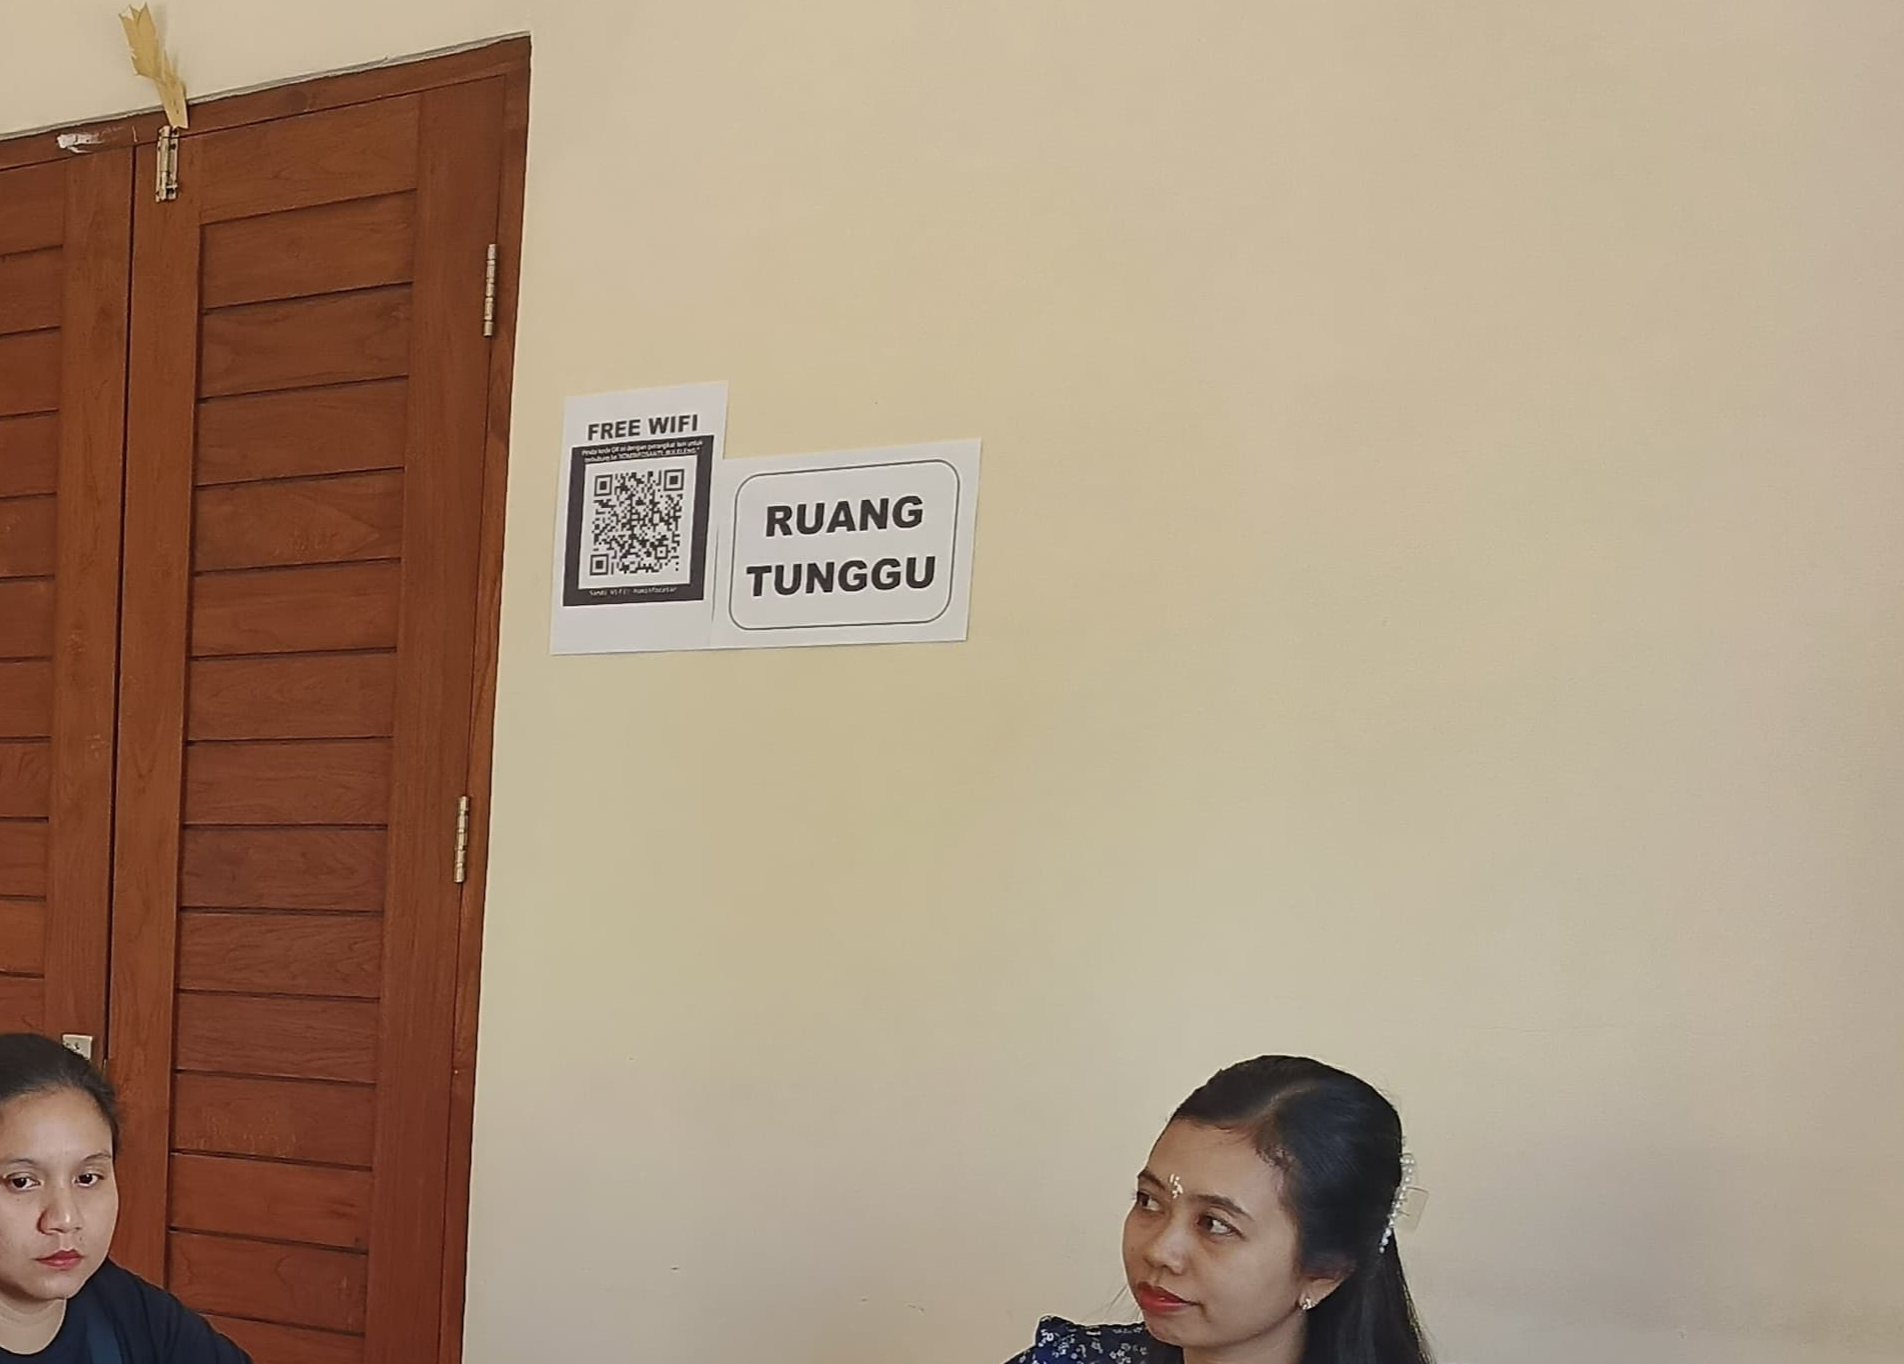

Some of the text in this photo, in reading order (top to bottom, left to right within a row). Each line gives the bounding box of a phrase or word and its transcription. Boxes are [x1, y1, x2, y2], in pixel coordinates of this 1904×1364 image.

[587, 414, 698, 441] FREE WIFI
[765, 495, 924, 538] RUANG
[746, 555, 936, 597] TUNGGU
